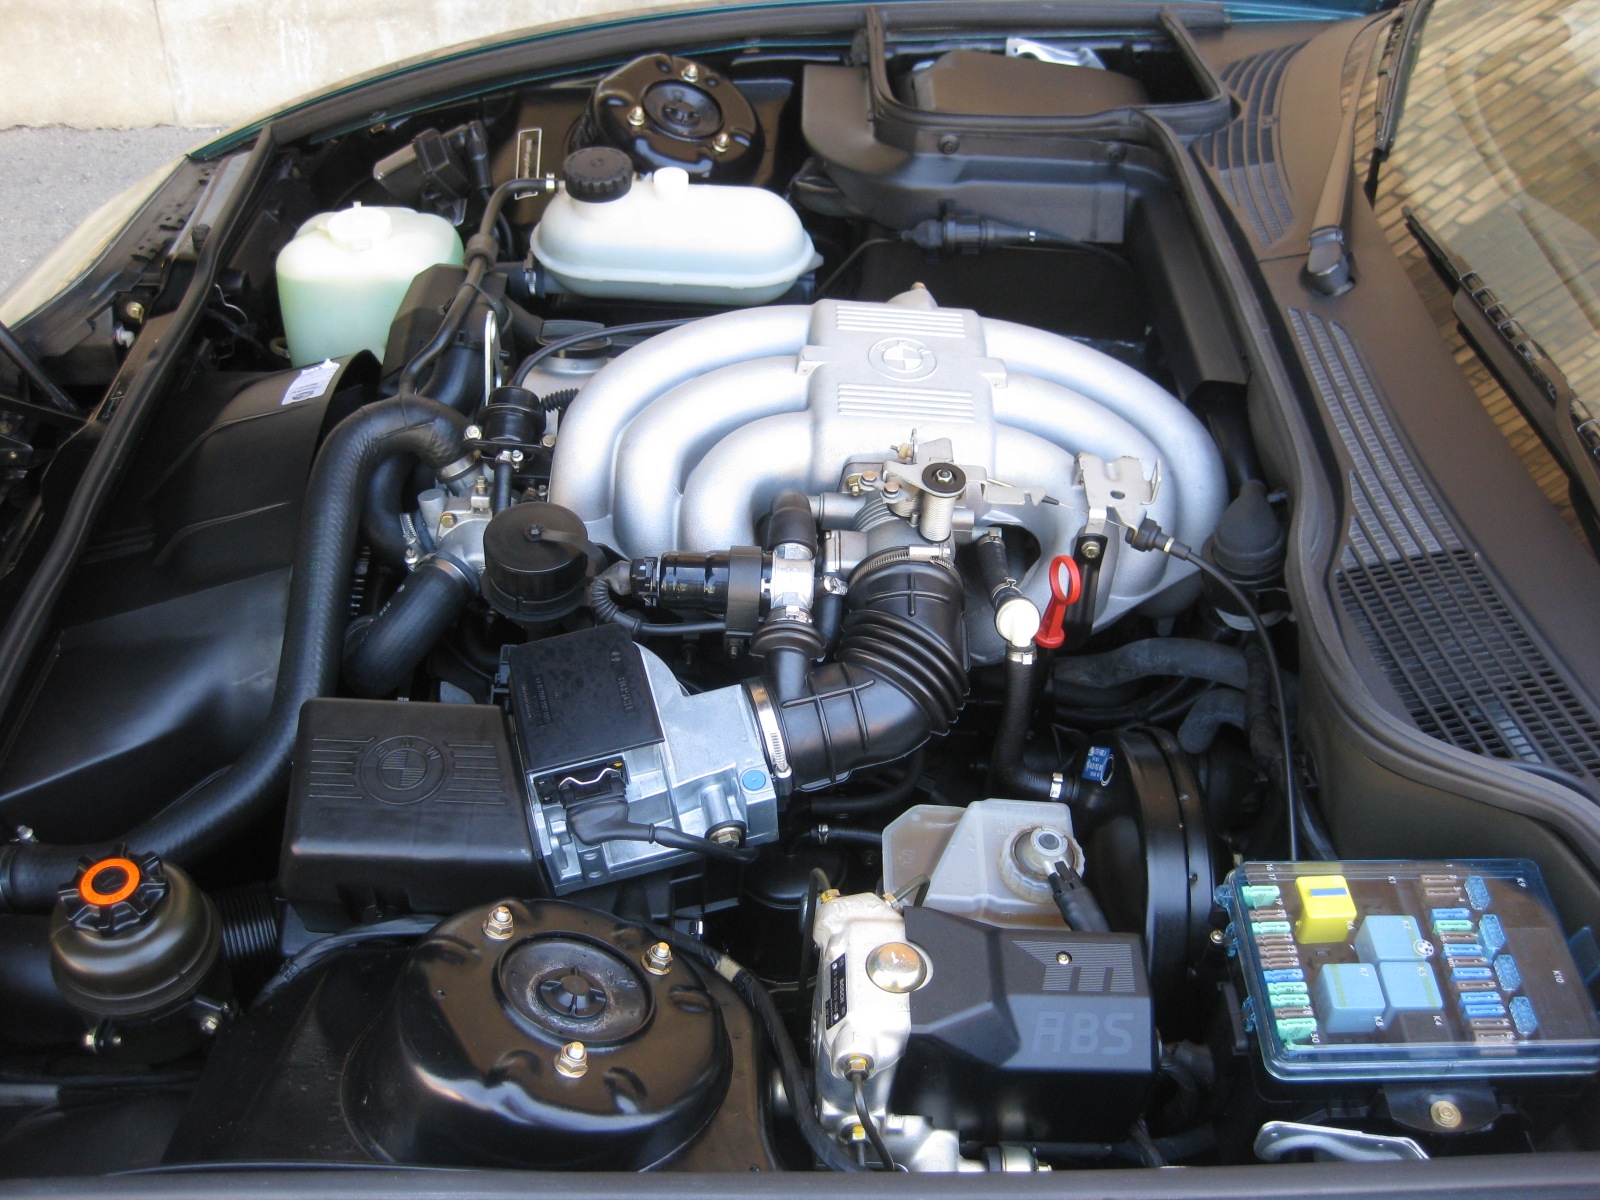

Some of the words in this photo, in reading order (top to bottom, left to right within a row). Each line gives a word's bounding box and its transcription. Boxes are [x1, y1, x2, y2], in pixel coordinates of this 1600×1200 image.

[374, 738, 441, 761] BMW
[1265, 863, 1275, 872] 16
[1268, 872, 1277, 881] 17
[1387, 875, 1397, 884] K1
[1516, 876, 1527, 888] K9
[1274, 897, 1283, 906] 19
[1276, 908, 1288, 919] 20
[1402, 920, 1412, 930] K2
[1283, 932, 1294, 942] 22
[1286, 944, 1299, 955] 23
[1289, 956, 1300, 967] 24
[1359, 966, 1370, 977] K7
[1417, 965, 1427, 977] K3
[1552, 969, 1565, 984] K10
[1373, 1014, 1385, 1027] K8
[1432, 1014, 1444, 1027] K4
[1031, 1011, 1134, 1055] ABS
[1310, 1032, 1320, 1044] 30
